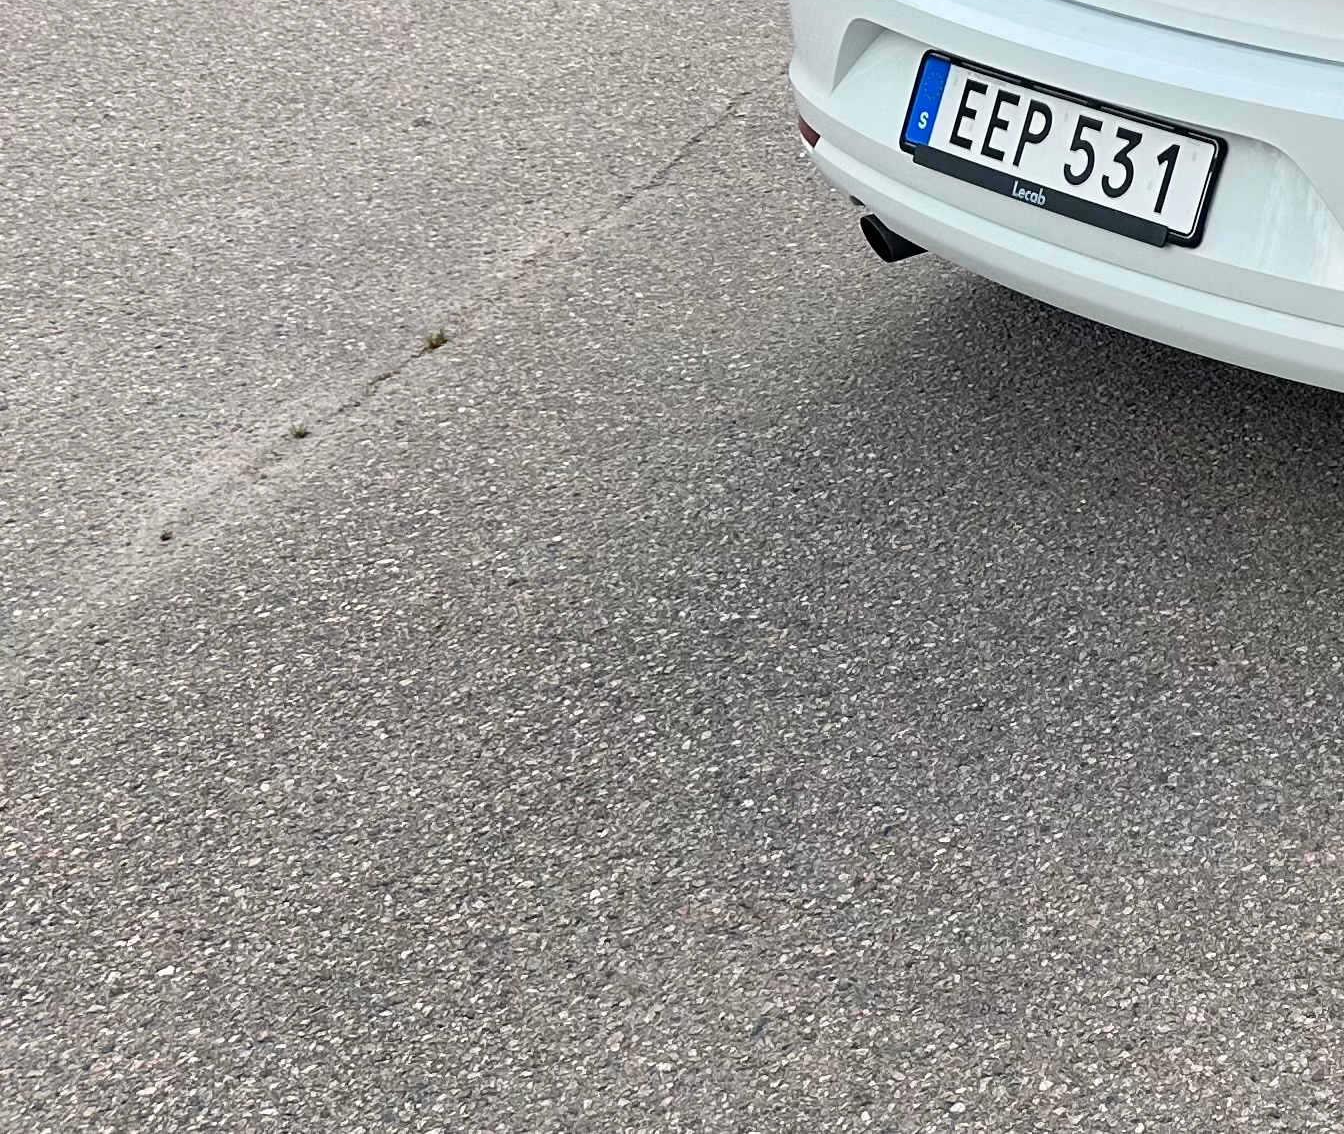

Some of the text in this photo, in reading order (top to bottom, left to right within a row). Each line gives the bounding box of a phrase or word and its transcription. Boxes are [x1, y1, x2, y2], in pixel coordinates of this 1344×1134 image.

[917, 110, 929, 131] S
[949, 78, 1181, 215] EEP 531
[1011, 179, 1047, 206] Lecab
